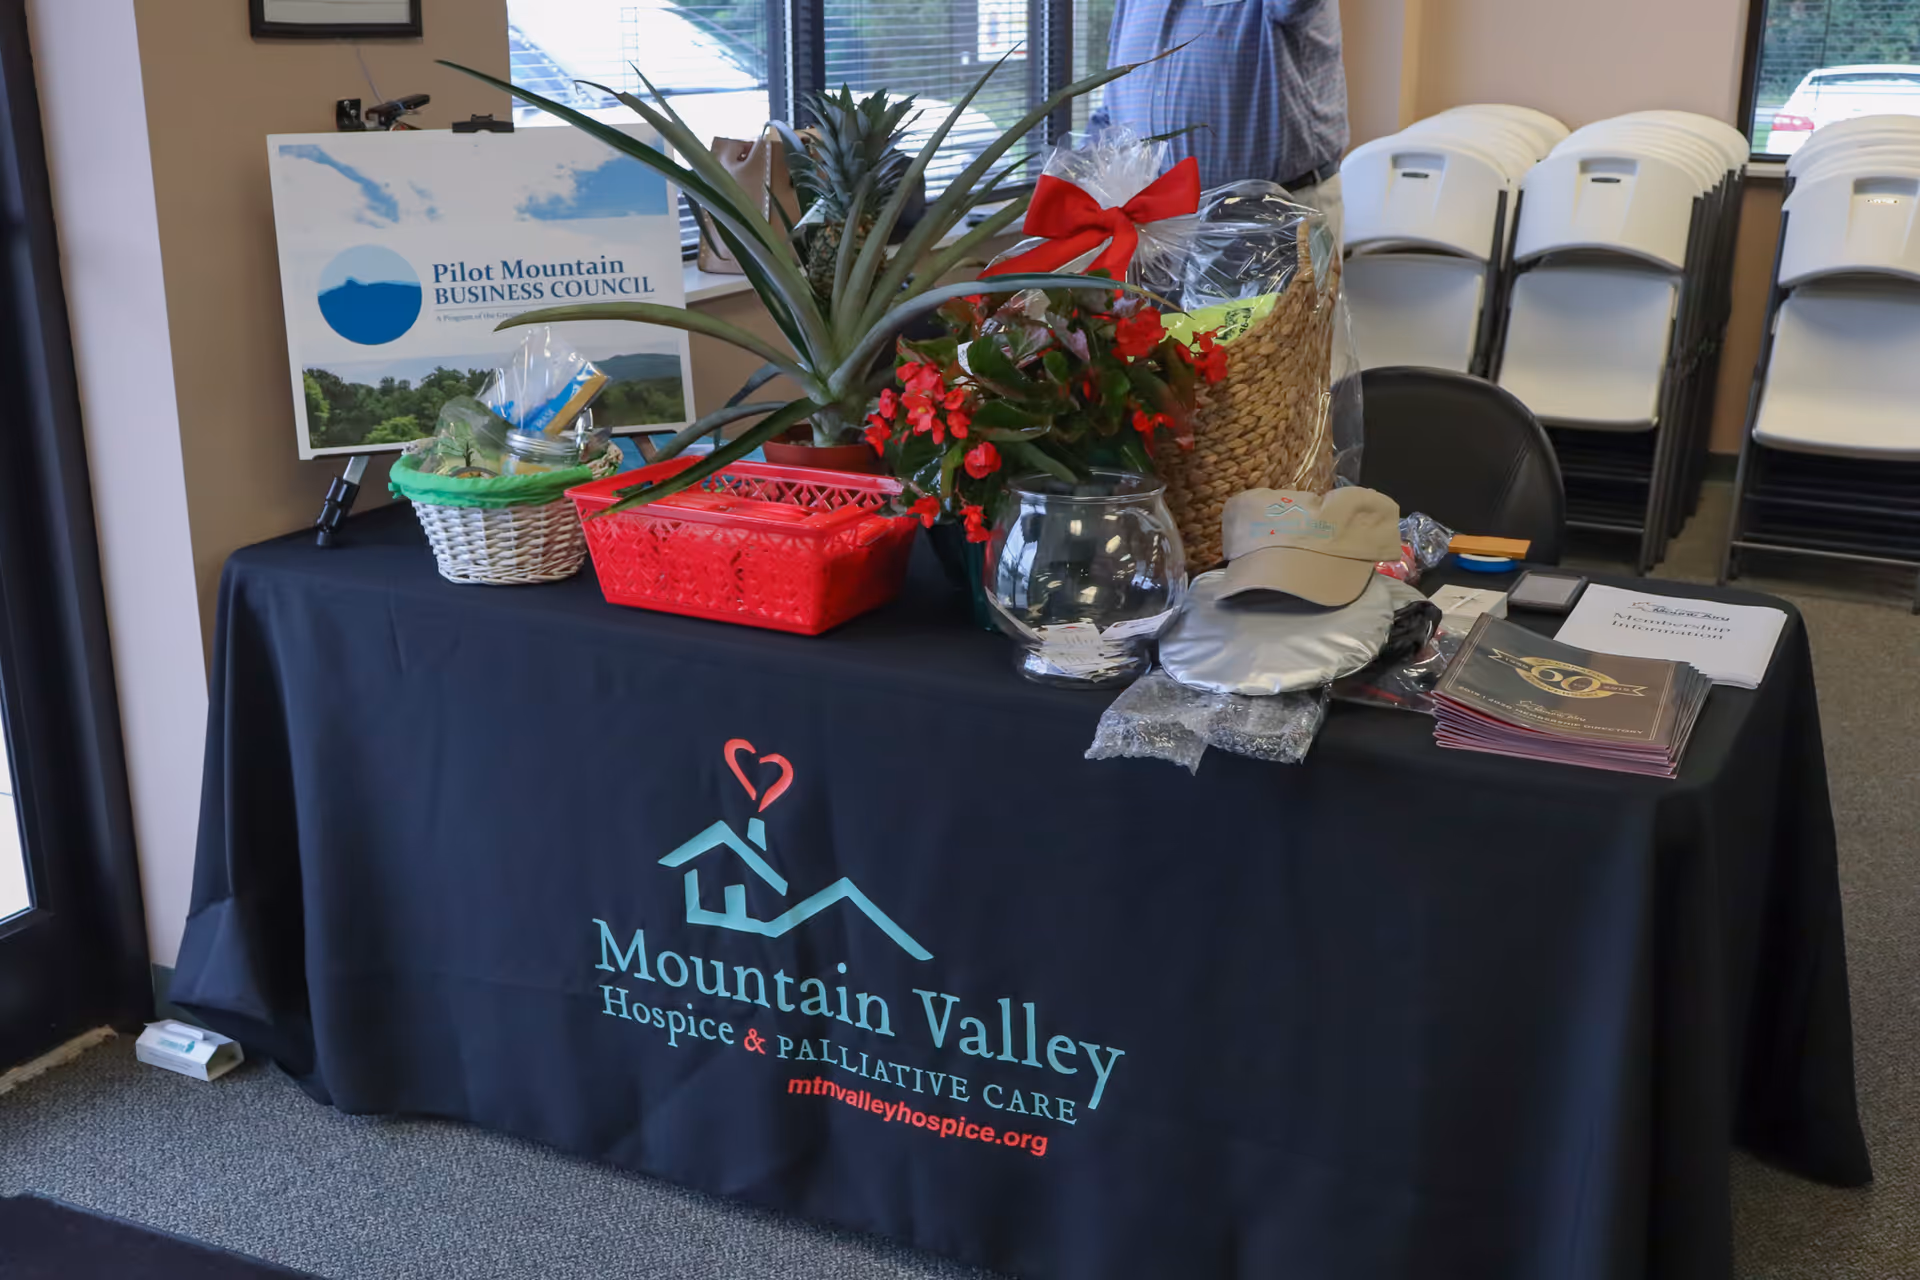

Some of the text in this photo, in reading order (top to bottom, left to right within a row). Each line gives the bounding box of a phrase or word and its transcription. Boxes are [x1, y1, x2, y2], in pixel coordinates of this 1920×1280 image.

[433, 255, 625, 283] Pilot Mountain
[434, 275, 655, 305] BUSINESS COUNCIL
[1612, 620, 1724, 641] Information
[1613, 612, 1731, 634] Membership
[1530, 664, 1602, 693] 60
[1515, 707, 1581, 728] MEMBERSHIP
[1583, 722, 1644, 735] DIRECTORY
[592, 917, 1126, 1111] Mountain Valley
[598, 984, 1078, 1126] Hospice & PALLIATIVE CARE
[786, 1074, 1049, 1157] mtnvalleyhospice.org
